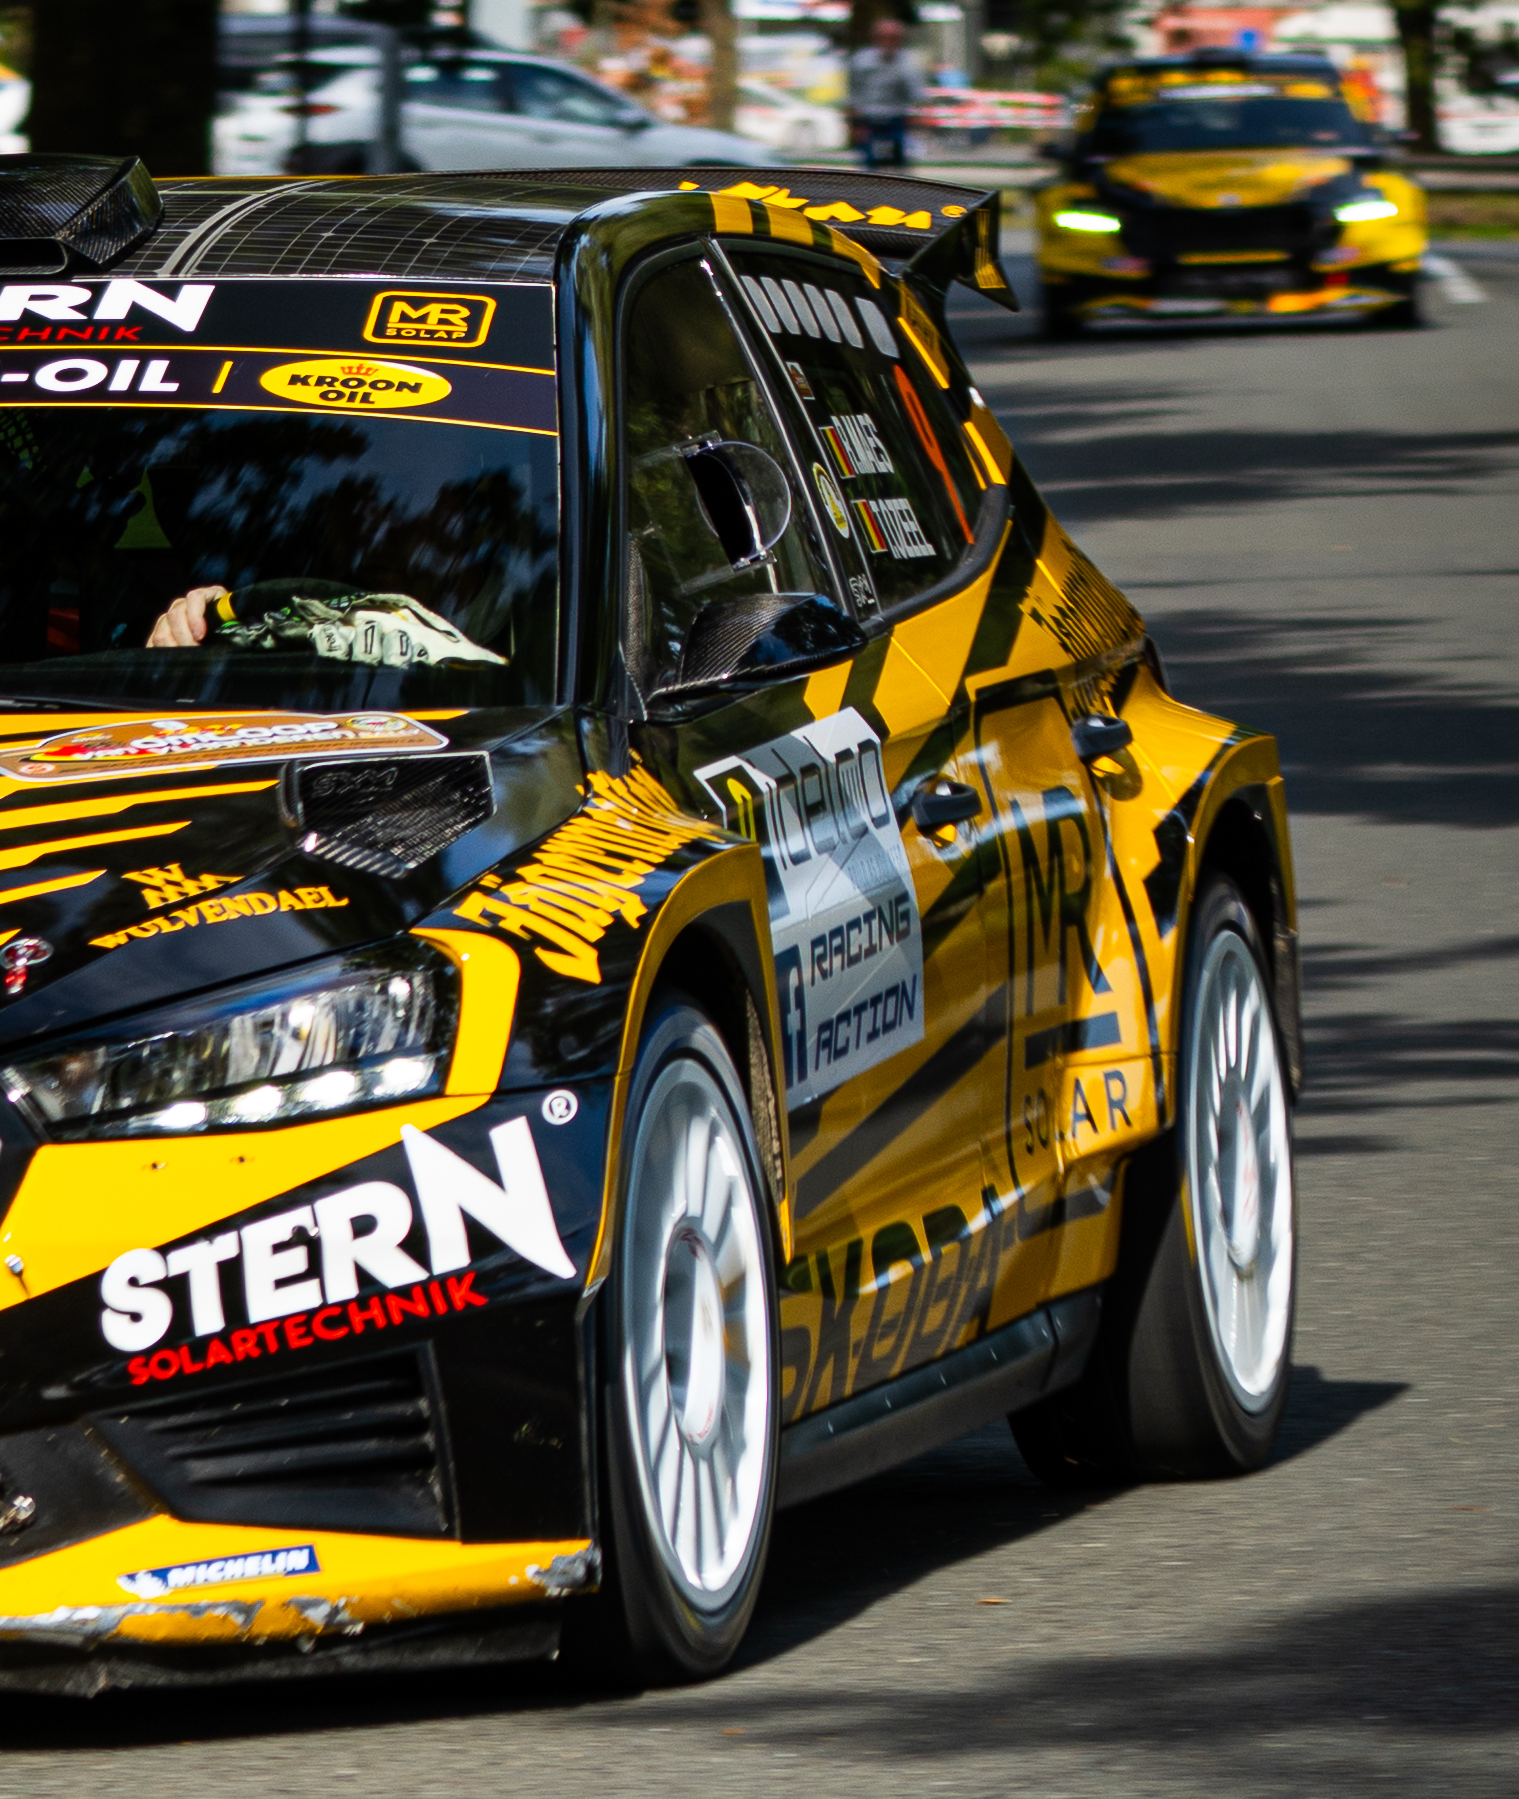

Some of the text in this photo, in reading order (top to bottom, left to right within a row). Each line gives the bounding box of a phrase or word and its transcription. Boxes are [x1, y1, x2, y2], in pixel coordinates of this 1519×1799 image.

[389, 301, 471, 327] MR
[287, 373, 423, 395] KROON
[317, 389, 376, 405] OIL
[87, 885, 350, 949] WULVENDAEL
[811, 891, 911, 987] RACING
[1010, 785, 1113, 1017] MR
[815, 973, 917, 1072] ACTION
[100, 1115, 578, 1353] STERN
[126, 1271, 488, 1386] SOLARTECHNIK
[167, 1548, 310, 1588] MICHELIN
